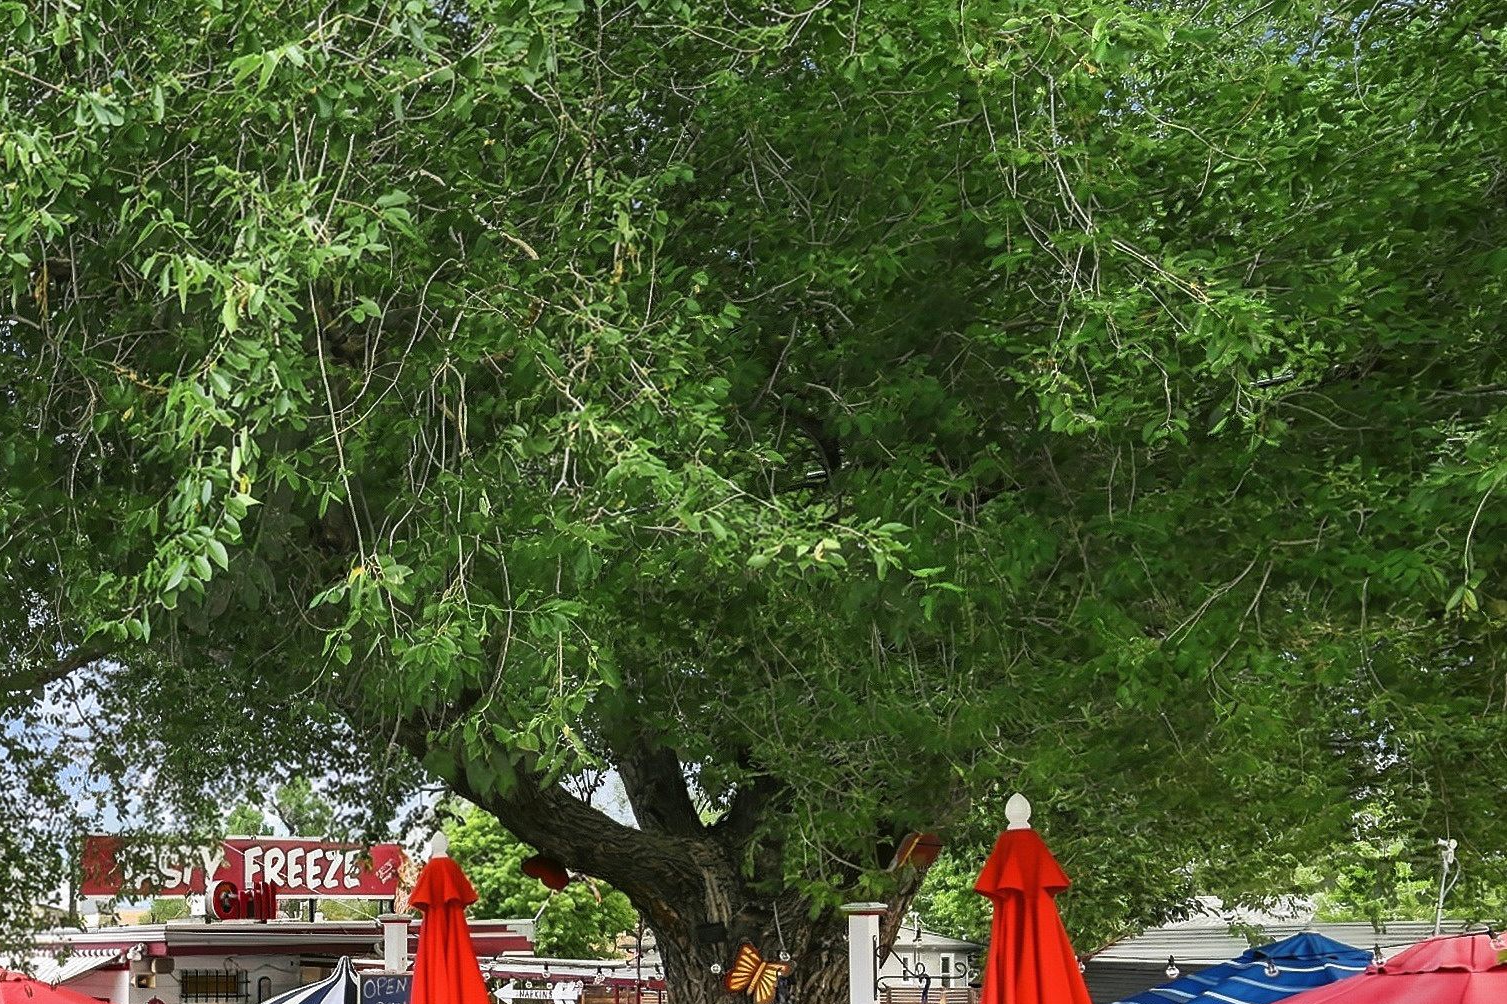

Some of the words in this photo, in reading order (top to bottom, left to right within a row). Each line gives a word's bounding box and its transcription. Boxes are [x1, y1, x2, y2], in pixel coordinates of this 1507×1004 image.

[245, 846, 362, 889] FREEZE
[363, 976, 408, 998] OPEN
[519, 990, 553, 999] NAPKINS
